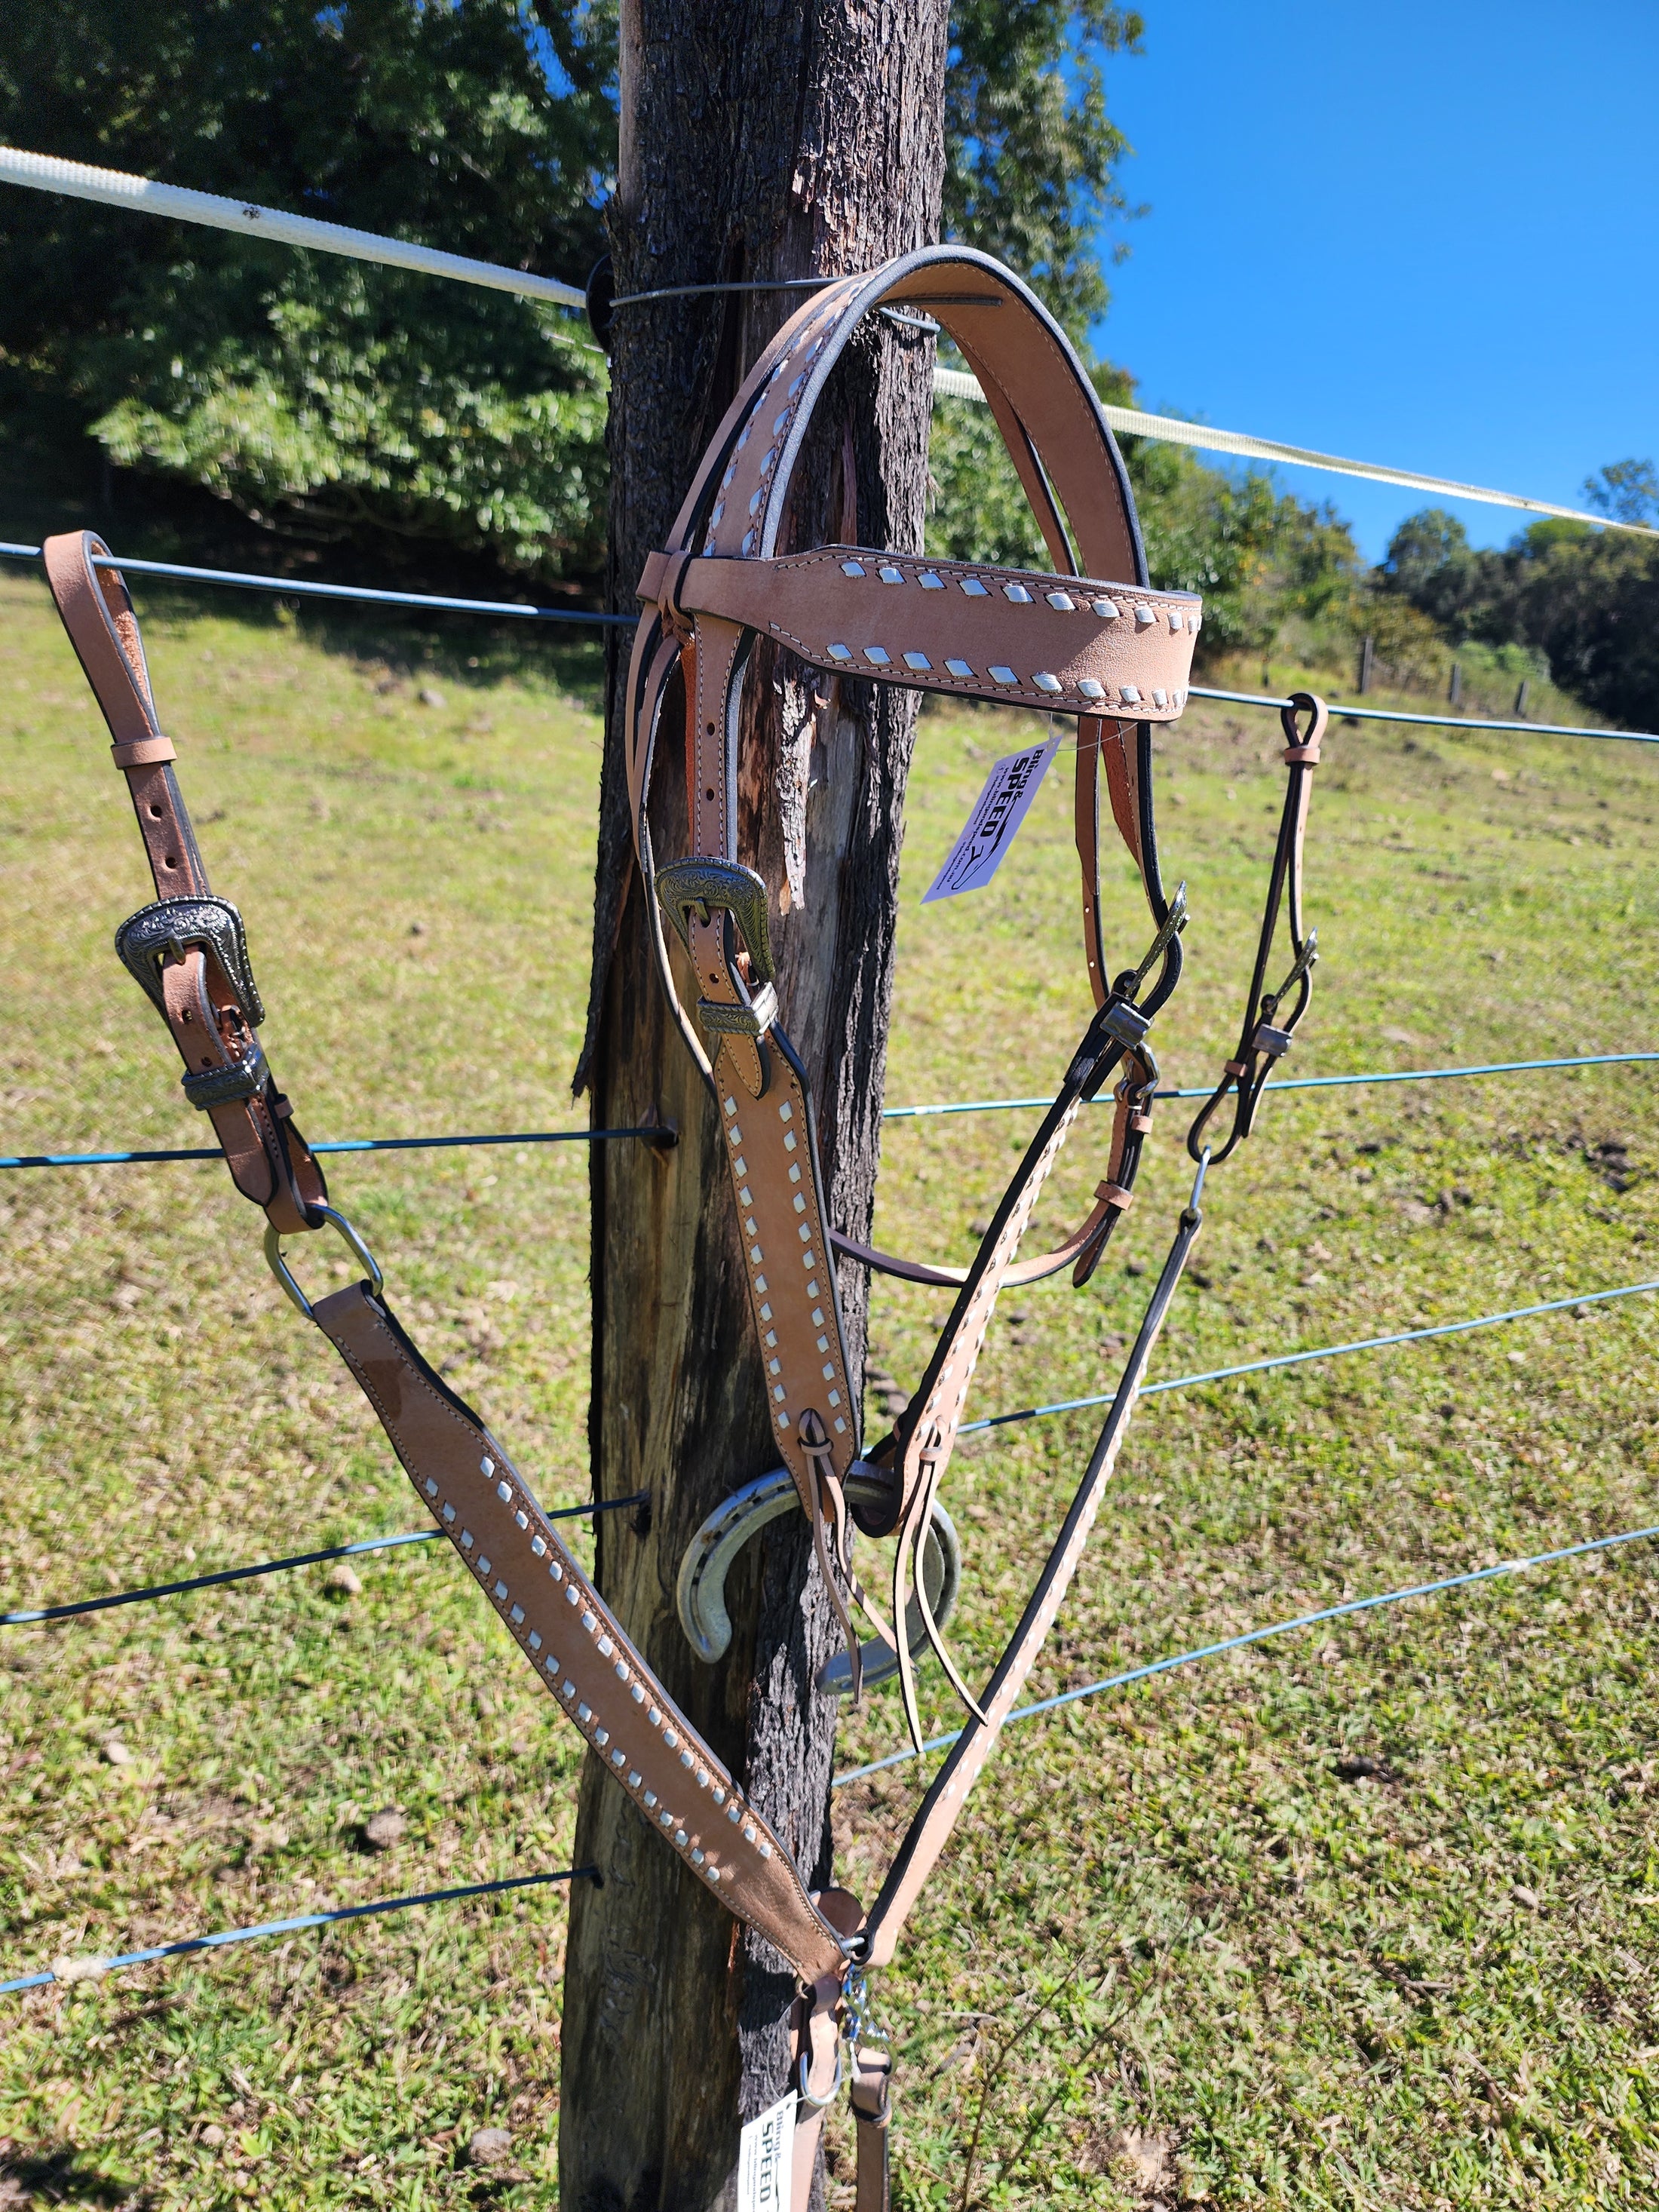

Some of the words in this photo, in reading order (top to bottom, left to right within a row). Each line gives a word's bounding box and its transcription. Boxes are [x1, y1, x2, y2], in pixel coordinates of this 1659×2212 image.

[980, 756, 1029, 837] SPEED
[1017, 749, 1045, 789] Bling
[760, 2120, 774, 2203] SPEED
[774, 2109, 784, 2152] Bling
